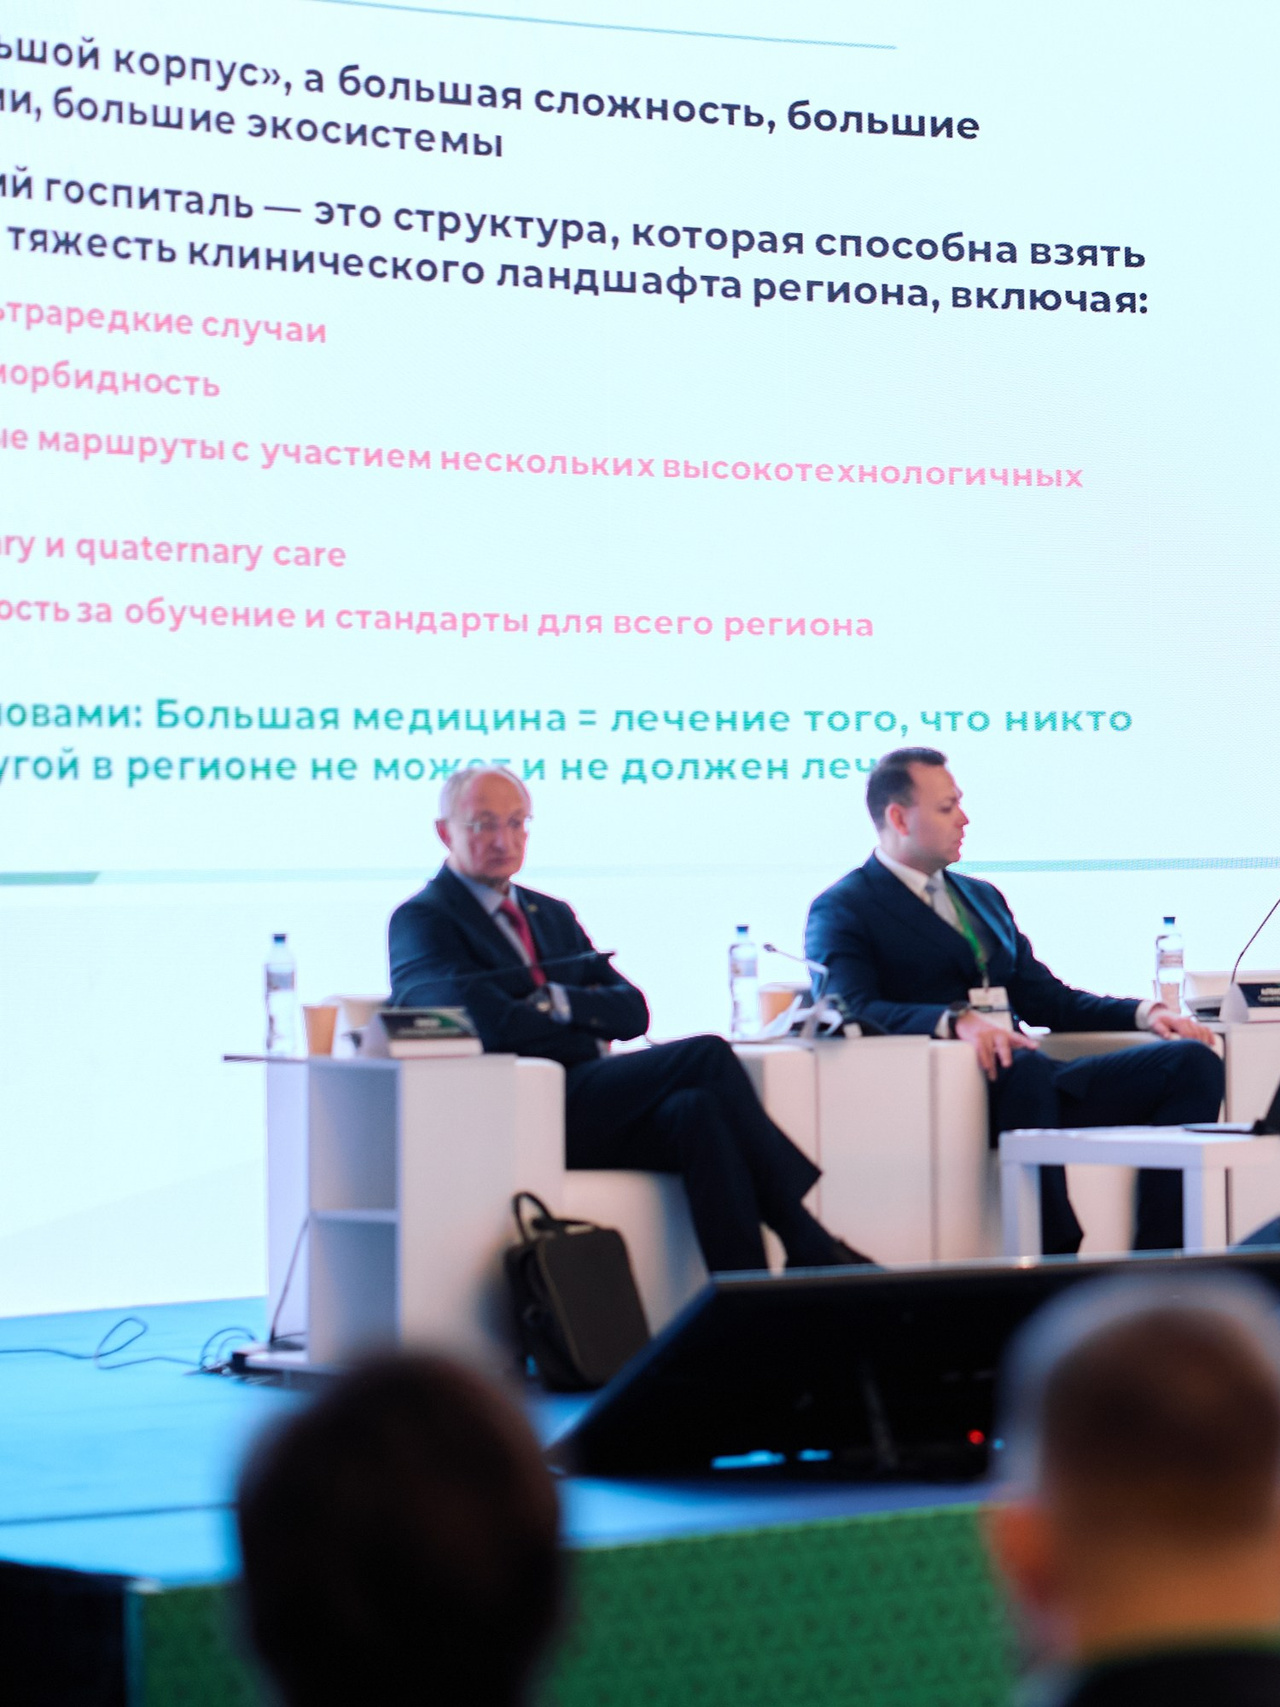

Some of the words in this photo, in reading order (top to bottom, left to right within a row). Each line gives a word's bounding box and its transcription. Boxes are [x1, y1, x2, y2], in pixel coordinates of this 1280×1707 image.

[113, 48, 293, 97] корпус»,
[303, 68, 324, 94] а
[337, 63, 522, 111] большая
[533, 89, 776, 135] сложность,
[786, 98, 981, 141] большие
[52, 85, 236, 135] большие
[246, 113, 503, 158] экосистемы
[45, 177, 255, 219] госпиталь
[314, 200, 382, 229] это
[393, 207, 620, 251] структура,
[632, 223, 804, 260] которая
[814, 231, 1018, 264] способна
[1030, 242, 1146, 269] взять
[6, 225, 178, 264] тяжесть
[188, 241, 485, 285] клинического
[496, 263, 742, 305] ландшафта
[753, 277, 941, 314] региона,
[951, 286, 1148, 315] включая:
[201, 316, 326, 347] случаи
[38, 431, 225, 465] маршруты
[231, 441, 249, 462] с
[261, 442, 431, 470] участием
[441, 450, 655, 477] нескольких
[663, 459, 1083, 488] высокотехнологичных
[0, 535, 36, 564] ry
[46, 537, 65, 558] и
[76, 536, 263, 572] quaternary
[273, 545, 346, 568] care
[77, 601, 113, 623] за
[125, 596, 296, 633] обучение
[305, 609, 325, 628] и
[335, 609, 529, 638] стандарты
[537, 614, 603, 637] для
[614, 615, 713, 635] всего
[724, 616, 874, 642] региона
[0, 702, 143, 729] овами:
[155, 697, 340, 731] Большая
[352, 707, 567, 736] медицина
[610, 709, 791, 733] лечение
[803, 710, 909, 738] того,
[920, 710, 991, 733] что
[1005, 710, 1133, 732] никто
[92, 755, 114, 781] в
[126, 755, 298, 789] регионе
[310, 757, 359, 782] не
[522, 758, 546, 782] и
[560, 758, 609, 781] не
[620, 757, 789, 785] должен
